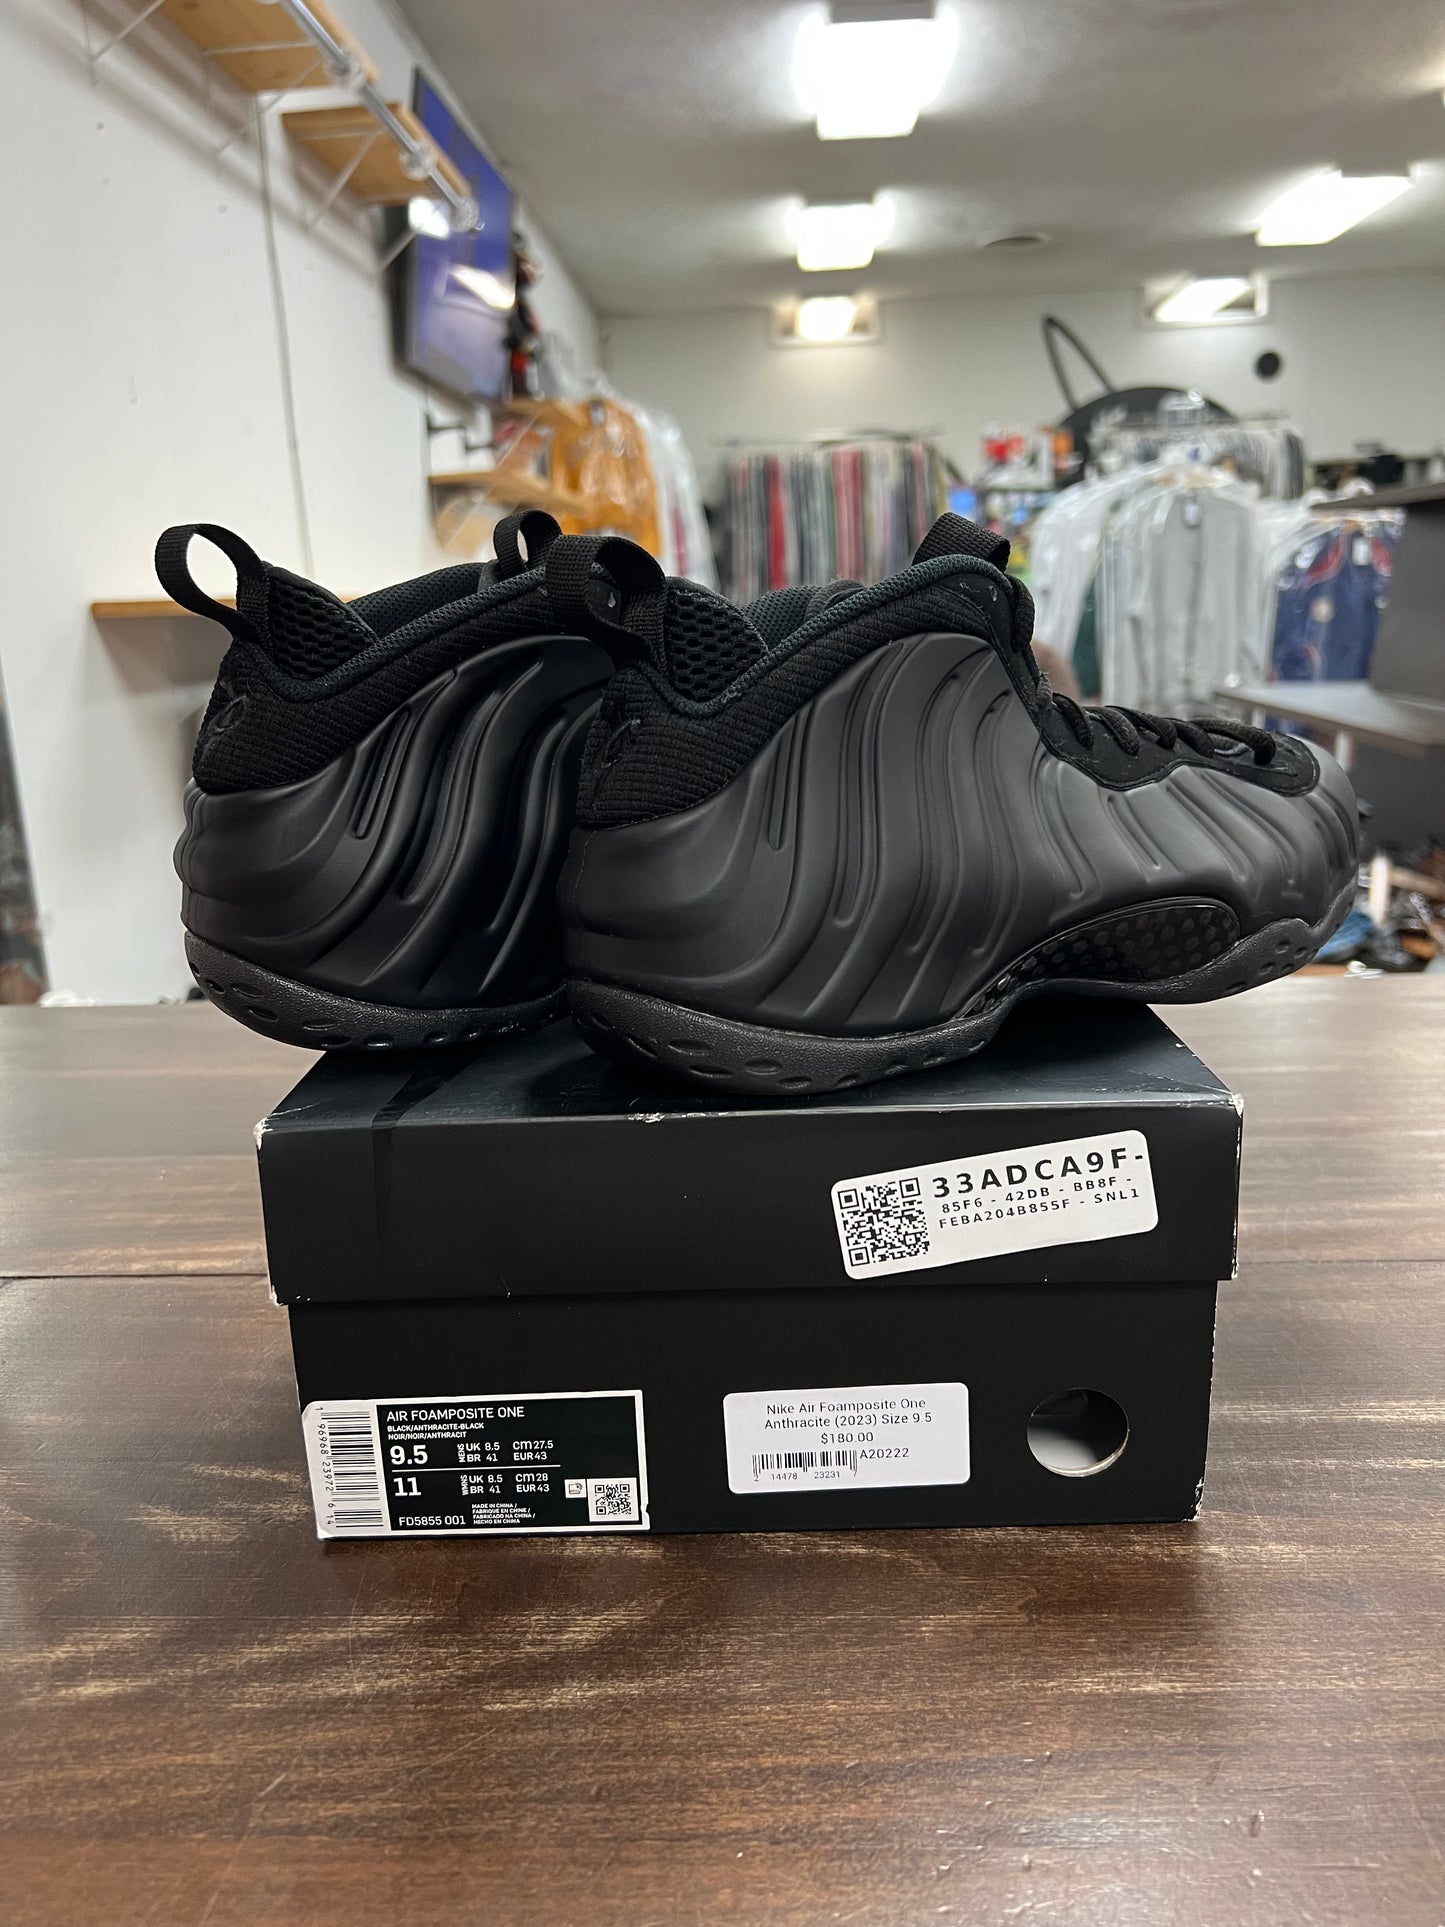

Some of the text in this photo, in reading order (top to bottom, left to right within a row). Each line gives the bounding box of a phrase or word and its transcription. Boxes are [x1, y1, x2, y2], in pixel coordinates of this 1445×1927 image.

[932, 1148, 1143, 1198] 33ADCA9F-
[942, 1199, 983, 1213] 85F6
[1005, 1187, 1049, 1202] 42DB
[1074, 1177, 1117, 1192] BB8F
[939, 1199, 1070, 1228] FEBA204B855F
[1094, 1189, 1139, 1204] SNL1
[767, 1399, 926, 1414] Nike Air Foamposite One
[387, 1407, 525, 1422] AIR FOAMPOSITE ONE
[765, 1416, 830, 1429] Anthracite
[835, 1414, 877, 1428] (2023)
[882, 1413, 908, 1424] Size
[388, 1422, 484, 1432] BLACK/ANTHRACITE-BLACK
[388, 1432, 466, 1440] NOIR/NOIR/ANTHRACIT
[821, 1432, 874, 1444] $180.00
[457, 1444, 465, 1462] MENS
[466, 1442, 500, 1451] UK 8.5
[318, 1424, 328, 1454] 96968
[323, 1462, 333, 1491] 23972
[390, 1445, 428, 1465] 9.5
[467, 1454, 481, 1462] BR
[860, 1448, 909, 1459] A20222
[469, 1475, 483, 1483] UK
[814, 1471, 840, 1479] 23231
[394, 1477, 421, 1496] 11
[470, 1485, 501, 1494] BR 41
[399, 1516, 466, 1526] FD5855 001
